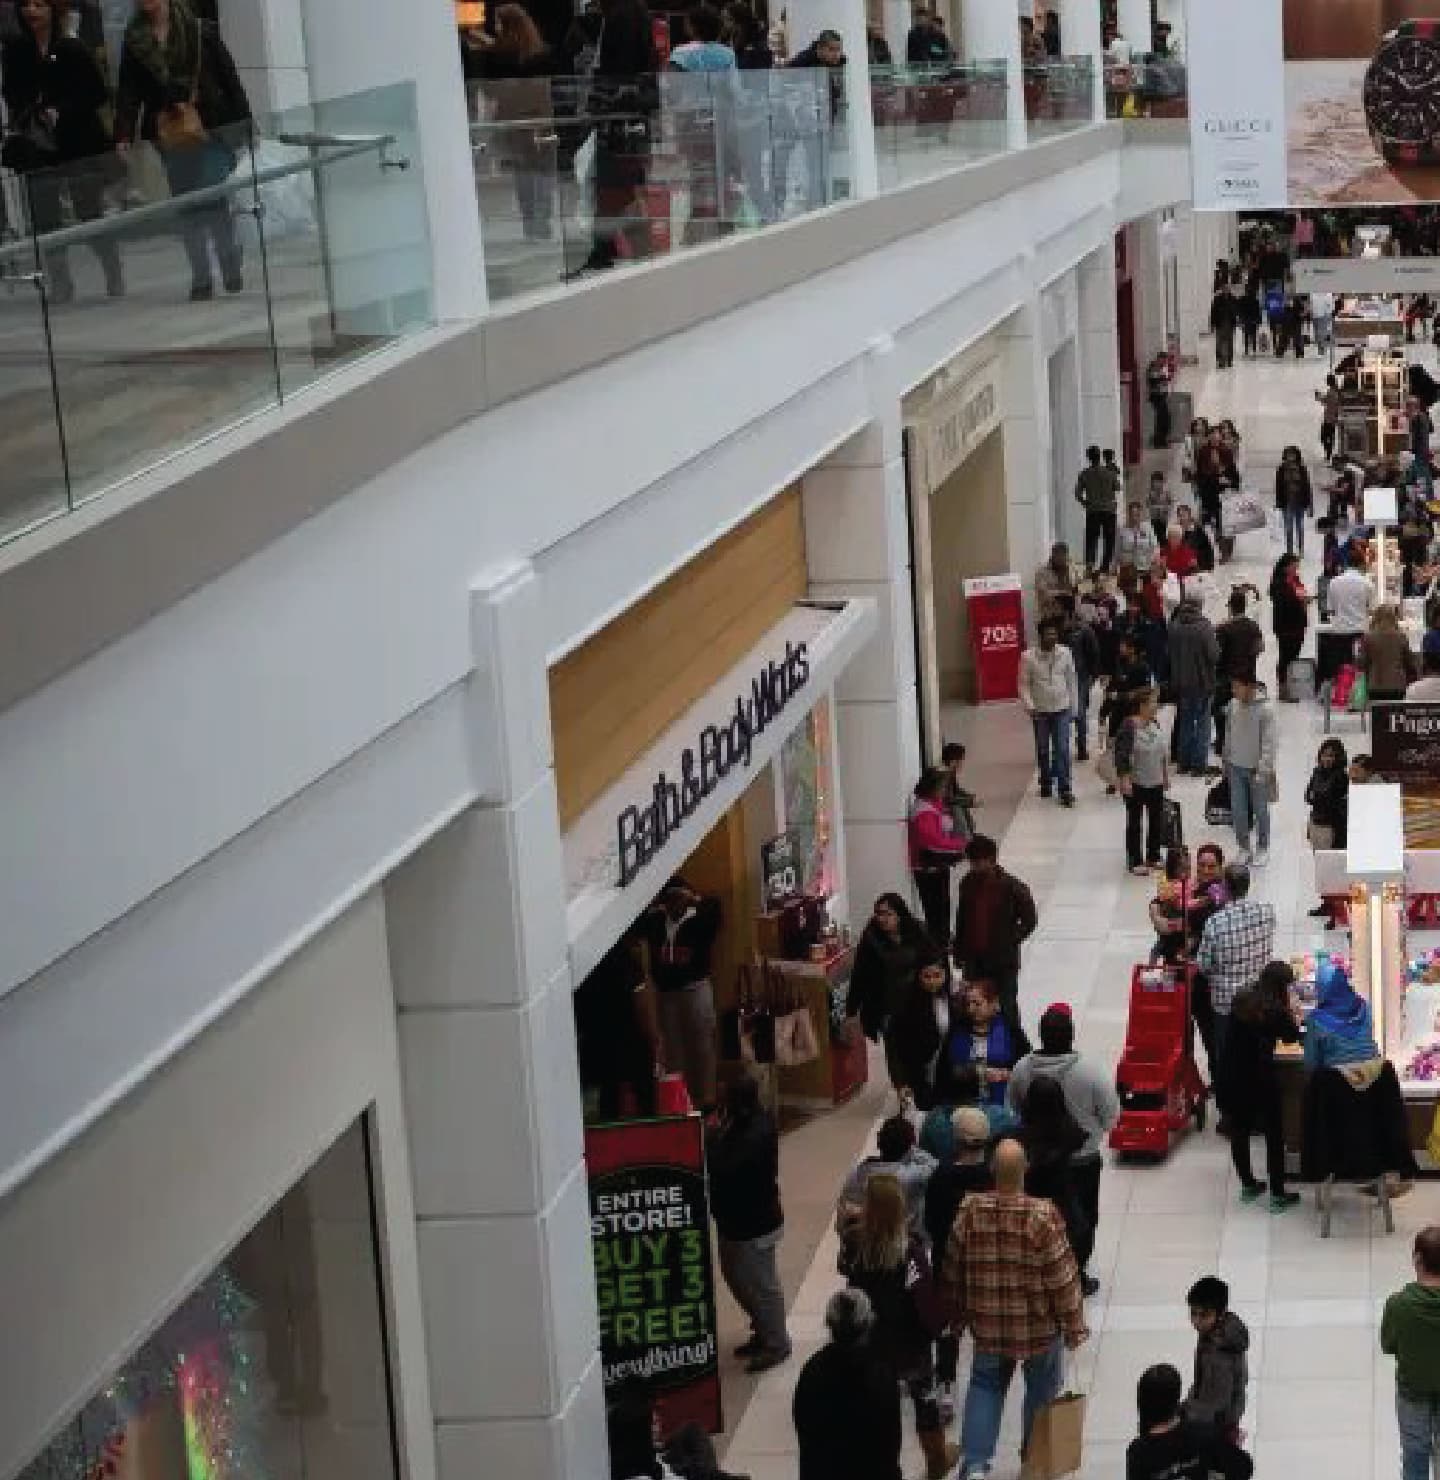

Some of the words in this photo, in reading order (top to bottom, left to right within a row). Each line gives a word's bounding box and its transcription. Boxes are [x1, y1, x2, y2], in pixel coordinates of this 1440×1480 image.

[615, 773, 680, 887] Bath
[681, 748, 701, 818] &
[700, 695, 751, 798] Body
[750, 640, 809, 737] Works
[590, 1204, 693, 1236] STORE!
[597, 1186, 683, 1212] ENTIRE
[594, 1232, 668, 1269] BUY
[680, 1230, 702, 1261] 3
[597, 1268, 671, 1308] GET
[682, 1265, 704, 1298] 3
[598, 1302, 708, 1344] FREE!
[602, 1333, 716, 1386] verything!
